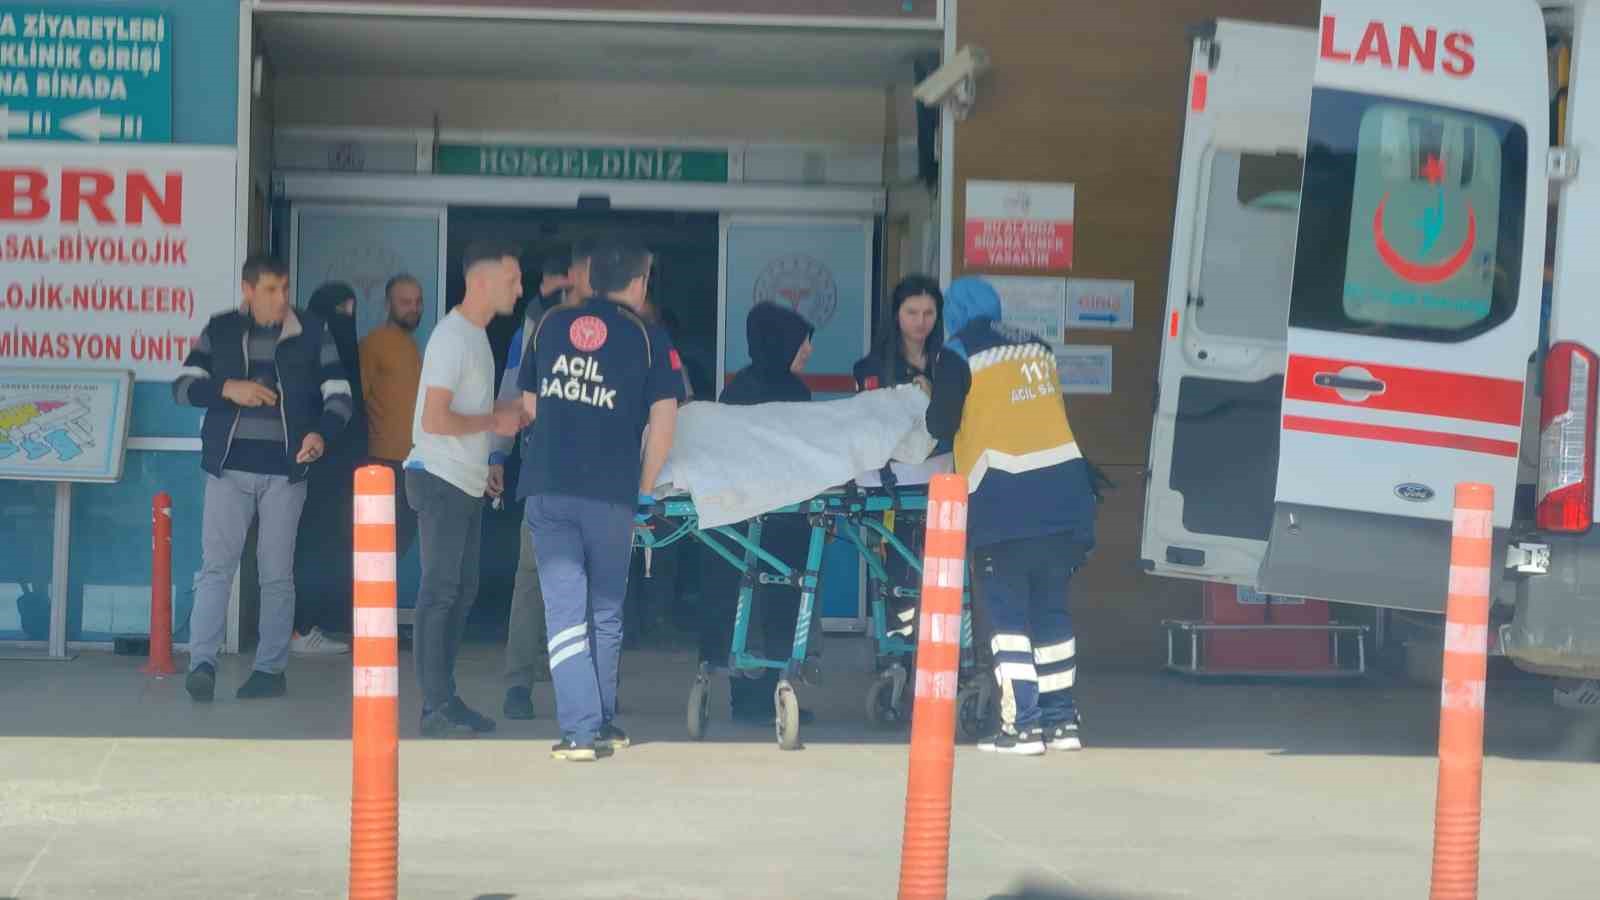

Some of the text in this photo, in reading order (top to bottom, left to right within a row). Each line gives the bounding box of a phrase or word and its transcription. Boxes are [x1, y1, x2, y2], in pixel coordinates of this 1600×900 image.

[24, 9, 165, 42] ZİYARETLERİ
[0, 38, 161, 78] KLİNİK GİRİŞİ
[1320, 16, 1475, 79] LANS
[37, 68, 128, 101] BİNADA
[0, 167, 183, 225] BRN
[0, 231, 188, 265] SAL-BİYOLOJİK
[0, 325, 121, 360] MİNASYON
